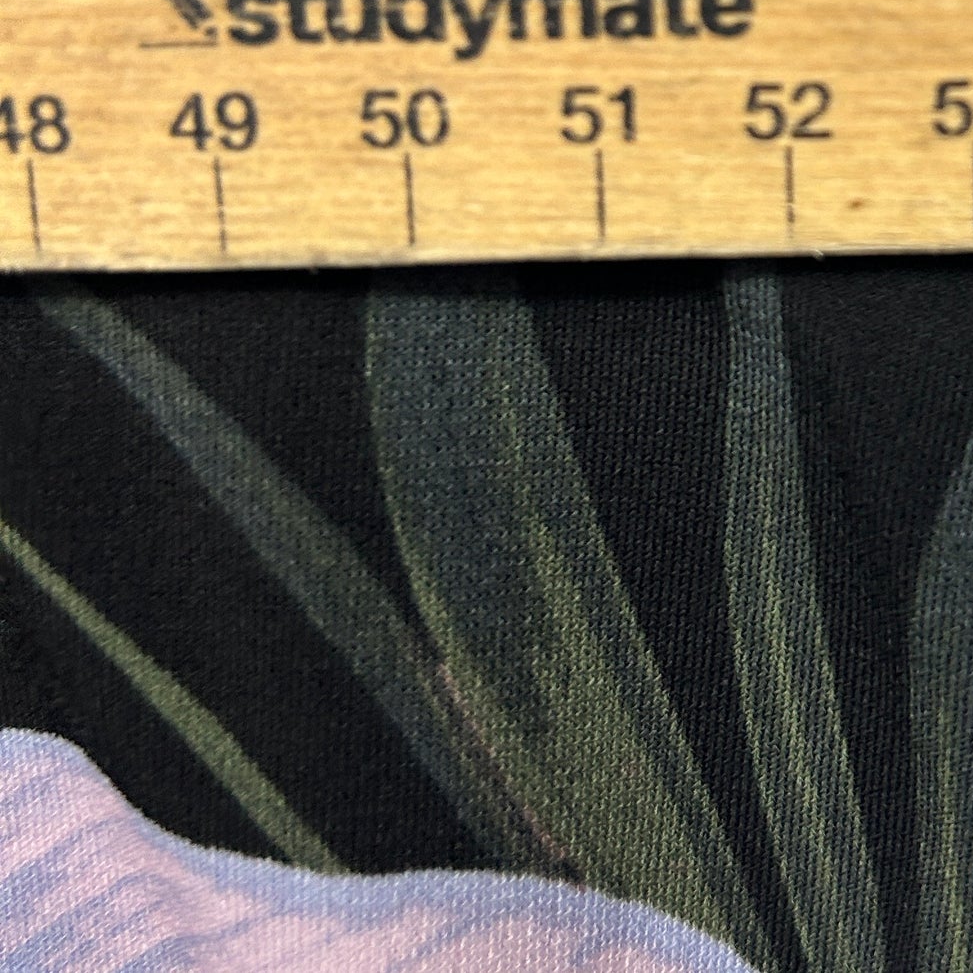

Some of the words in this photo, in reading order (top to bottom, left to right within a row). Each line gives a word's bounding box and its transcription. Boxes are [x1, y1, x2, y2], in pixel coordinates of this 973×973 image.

[169, 91, 259, 152] 49
[360, 89, 451, 149] 50
[560, 86, 639, 145] 51
[743, 81, 833, 140] 52
